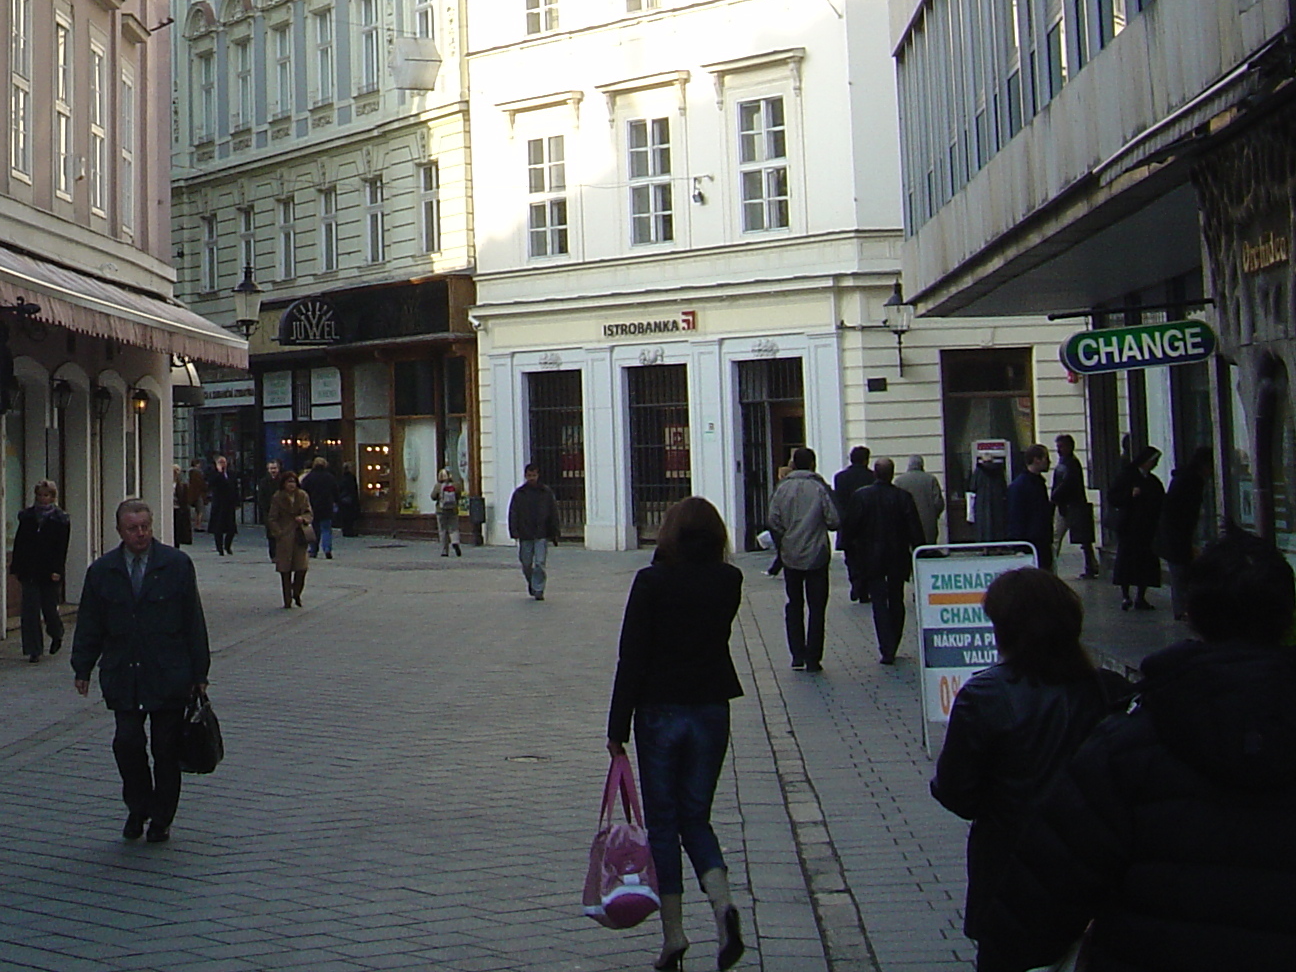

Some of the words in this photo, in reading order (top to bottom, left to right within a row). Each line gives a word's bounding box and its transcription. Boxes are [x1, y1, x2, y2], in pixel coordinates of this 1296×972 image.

[602, 319, 680, 337] ISTROBANKA
[1077, 327, 1205, 367] CHANGE
[931, 569, 1000, 590] ZMENÁR
[933, 631, 971, 647] NÁKUP
[974, 633, 982, 646] A
